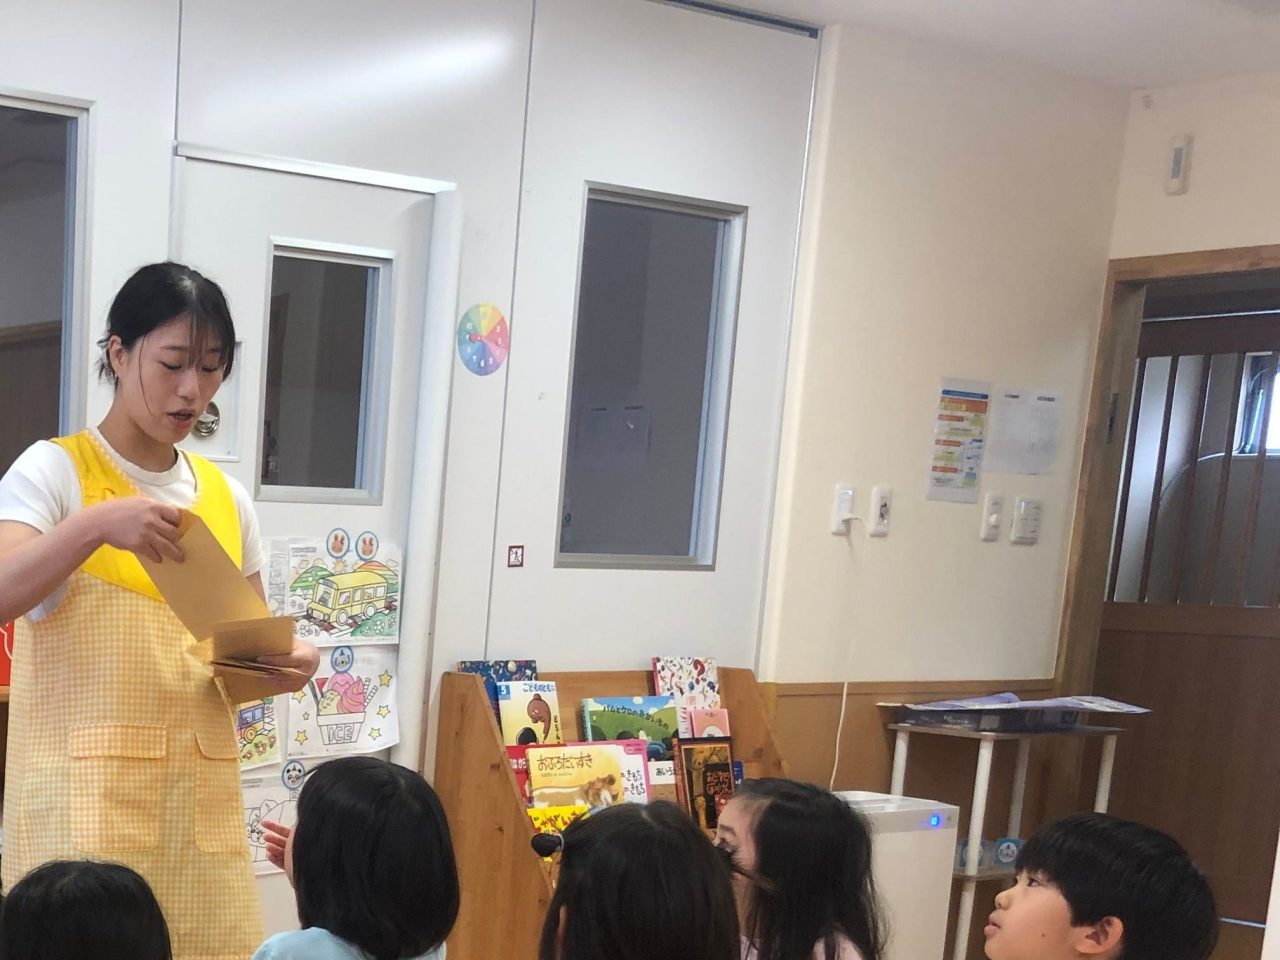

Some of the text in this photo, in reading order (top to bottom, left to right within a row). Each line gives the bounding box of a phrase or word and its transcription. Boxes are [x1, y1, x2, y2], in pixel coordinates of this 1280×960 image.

[327, 723, 354, 743] ICE
[537, 752, 593, 772] おふろだいすき
